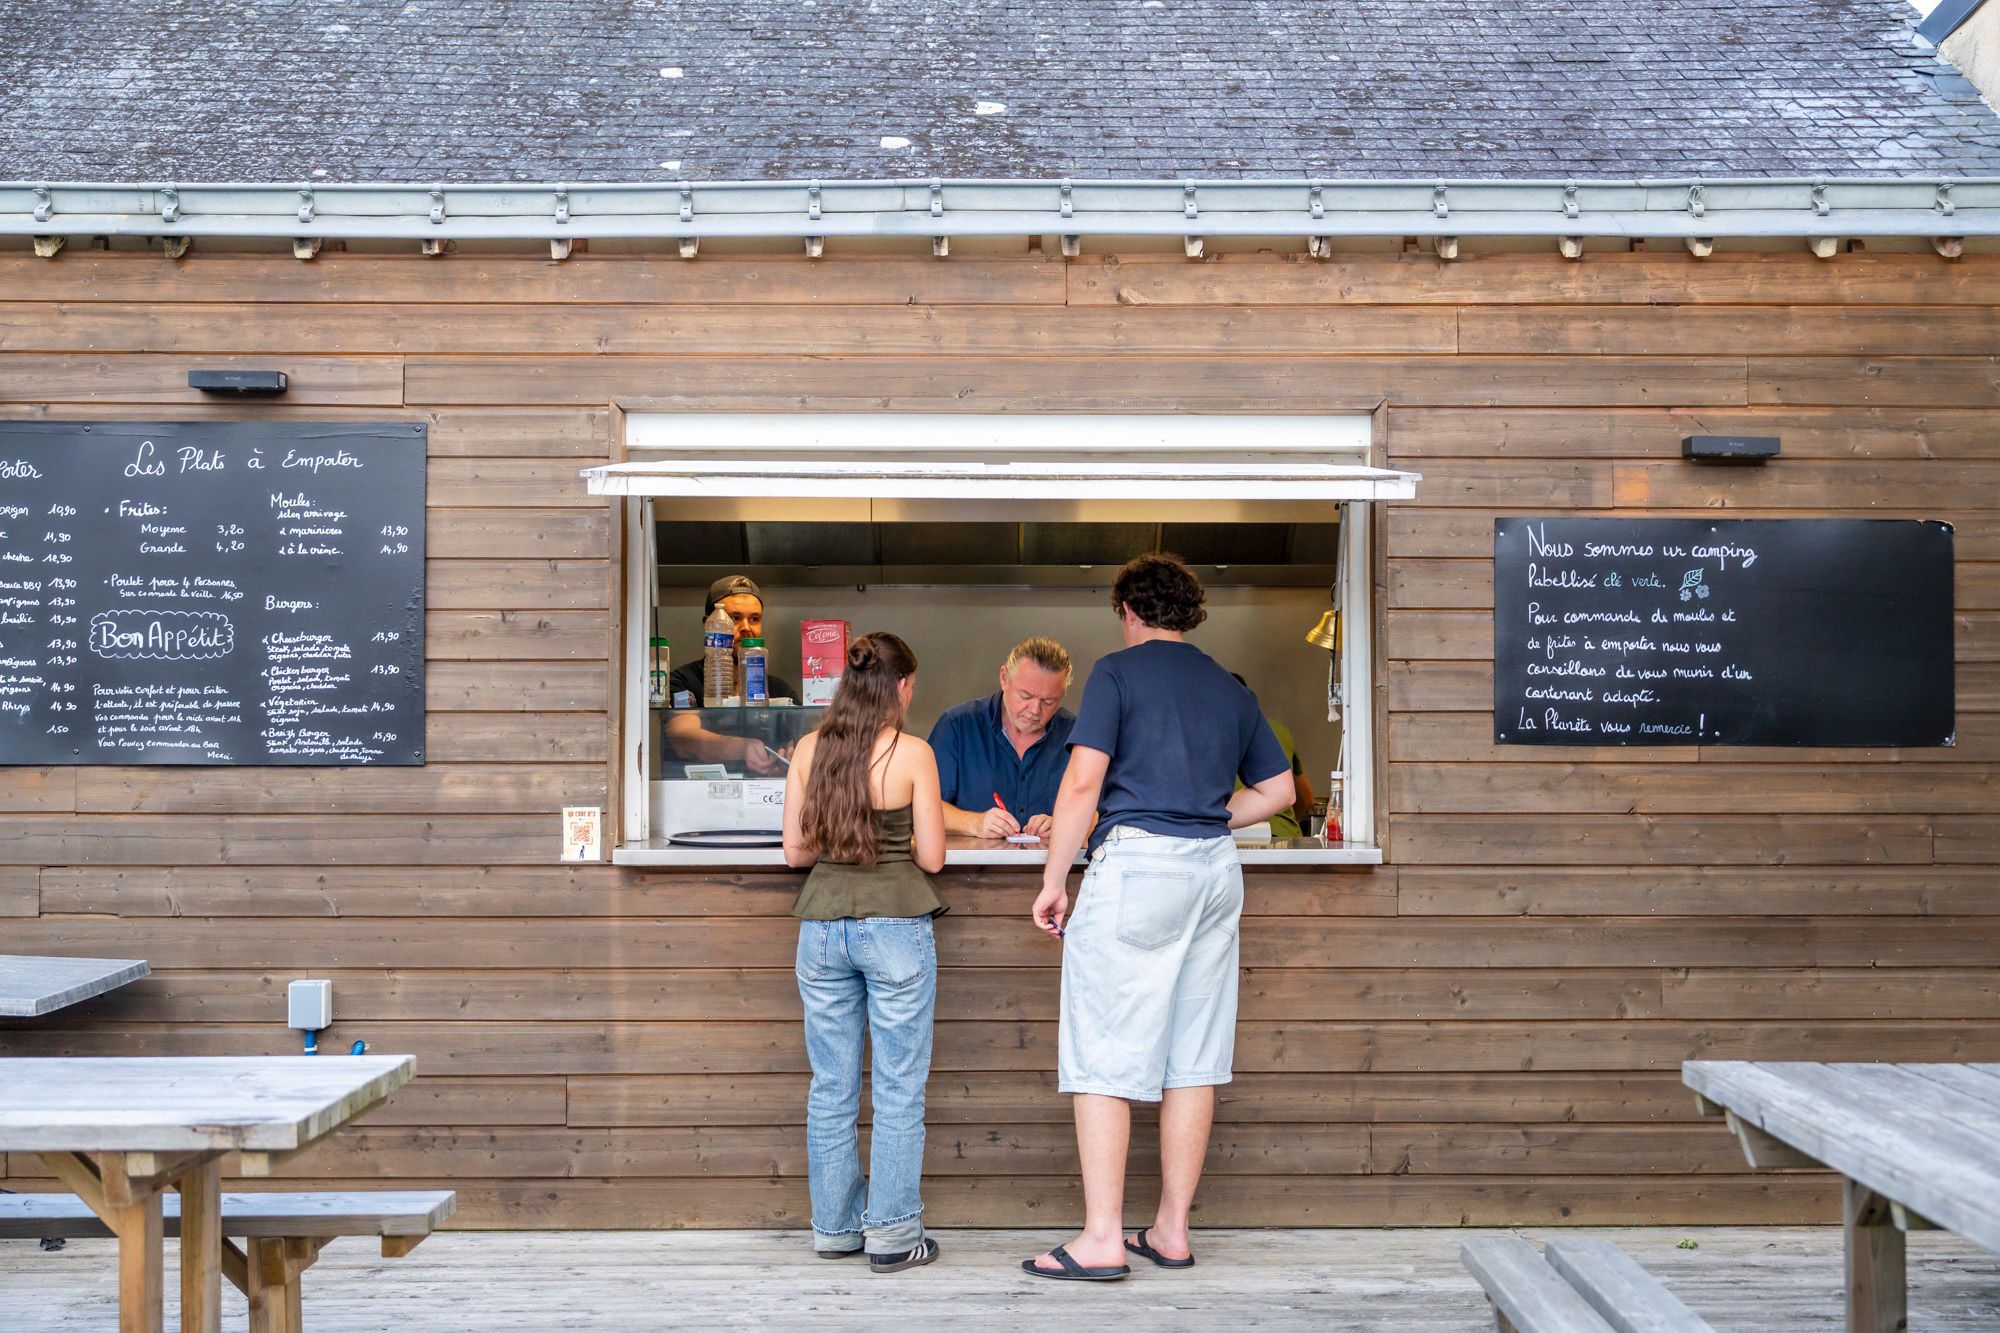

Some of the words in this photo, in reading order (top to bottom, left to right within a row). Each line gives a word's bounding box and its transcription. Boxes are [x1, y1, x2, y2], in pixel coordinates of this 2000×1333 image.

[124, 441, 165, 477] Les
[248, 448, 266, 469] à
[217, 524, 244, 536] 3,20
[380, 526, 408, 537] 13,90
[44, 531, 71, 543] 11,90
[140, 542, 187, 553] Grande
[216, 541, 245, 552] 4,20
[380, 543, 408, 555] 14,90
[1527, 522, 1574, 557] Nous
[1584, 542, 1654, 557] sommes
[1663, 546, 1687, 557] un
[1691, 542, 1758, 571] camping
[48, 578, 77, 590] 13,90
[111, 574, 144, 587] Poulet
[149, 577, 179, 590] pour
[183, 577, 190, 588] 4
[1603, 571, 1622, 587] clé
[1528, 602, 1558, 625] Pour
[1563, 610, 1641, 624] commande
[1651, 608, 1668, 623] de
[1673, 608, 1715, 623] moules
[1721, 609, 1736, 622] et
[100, 621, 143, 648] Bon
[149, 622, 225, 651] Appétit
[371, 631, 399, 643] 13,90
[47, 639, 77, 650] 13,90
[1527, 637, 1541, 650] de
[1547, 635, 1577, 660] frites
[1583, 635, 1596, 650] à
[1601, 635, 1657, 657] emporter
[1662, 643, 1690, 653] nous
[1695, 643, 1721, 653] vous
[47, 656, 77, 666] 13,90
[370, 665, 399, 675] 13,90
[1527, 660, 1606, 676] conseillons
[1615, 665, 1635, 678] de
[1637, 669, 1668, 680] vous
[1672, 665, 1714, 678] munir
[1721, 664, 1753, 680] d'un
[93, 684, 115, 695] Pour
[165, 685, 176, 694] et
[1525, 685, 1594, 701] contenant
[1518, 706, 1537, 730] La
[1545, 707, 1592, 731] Planète
[1600, 721, 1631, 733] vous
[1638, 724, 1693, 735] remercie
[46, 725, 69, 734] 1,50
[98, 737, 115, 747] Vous
